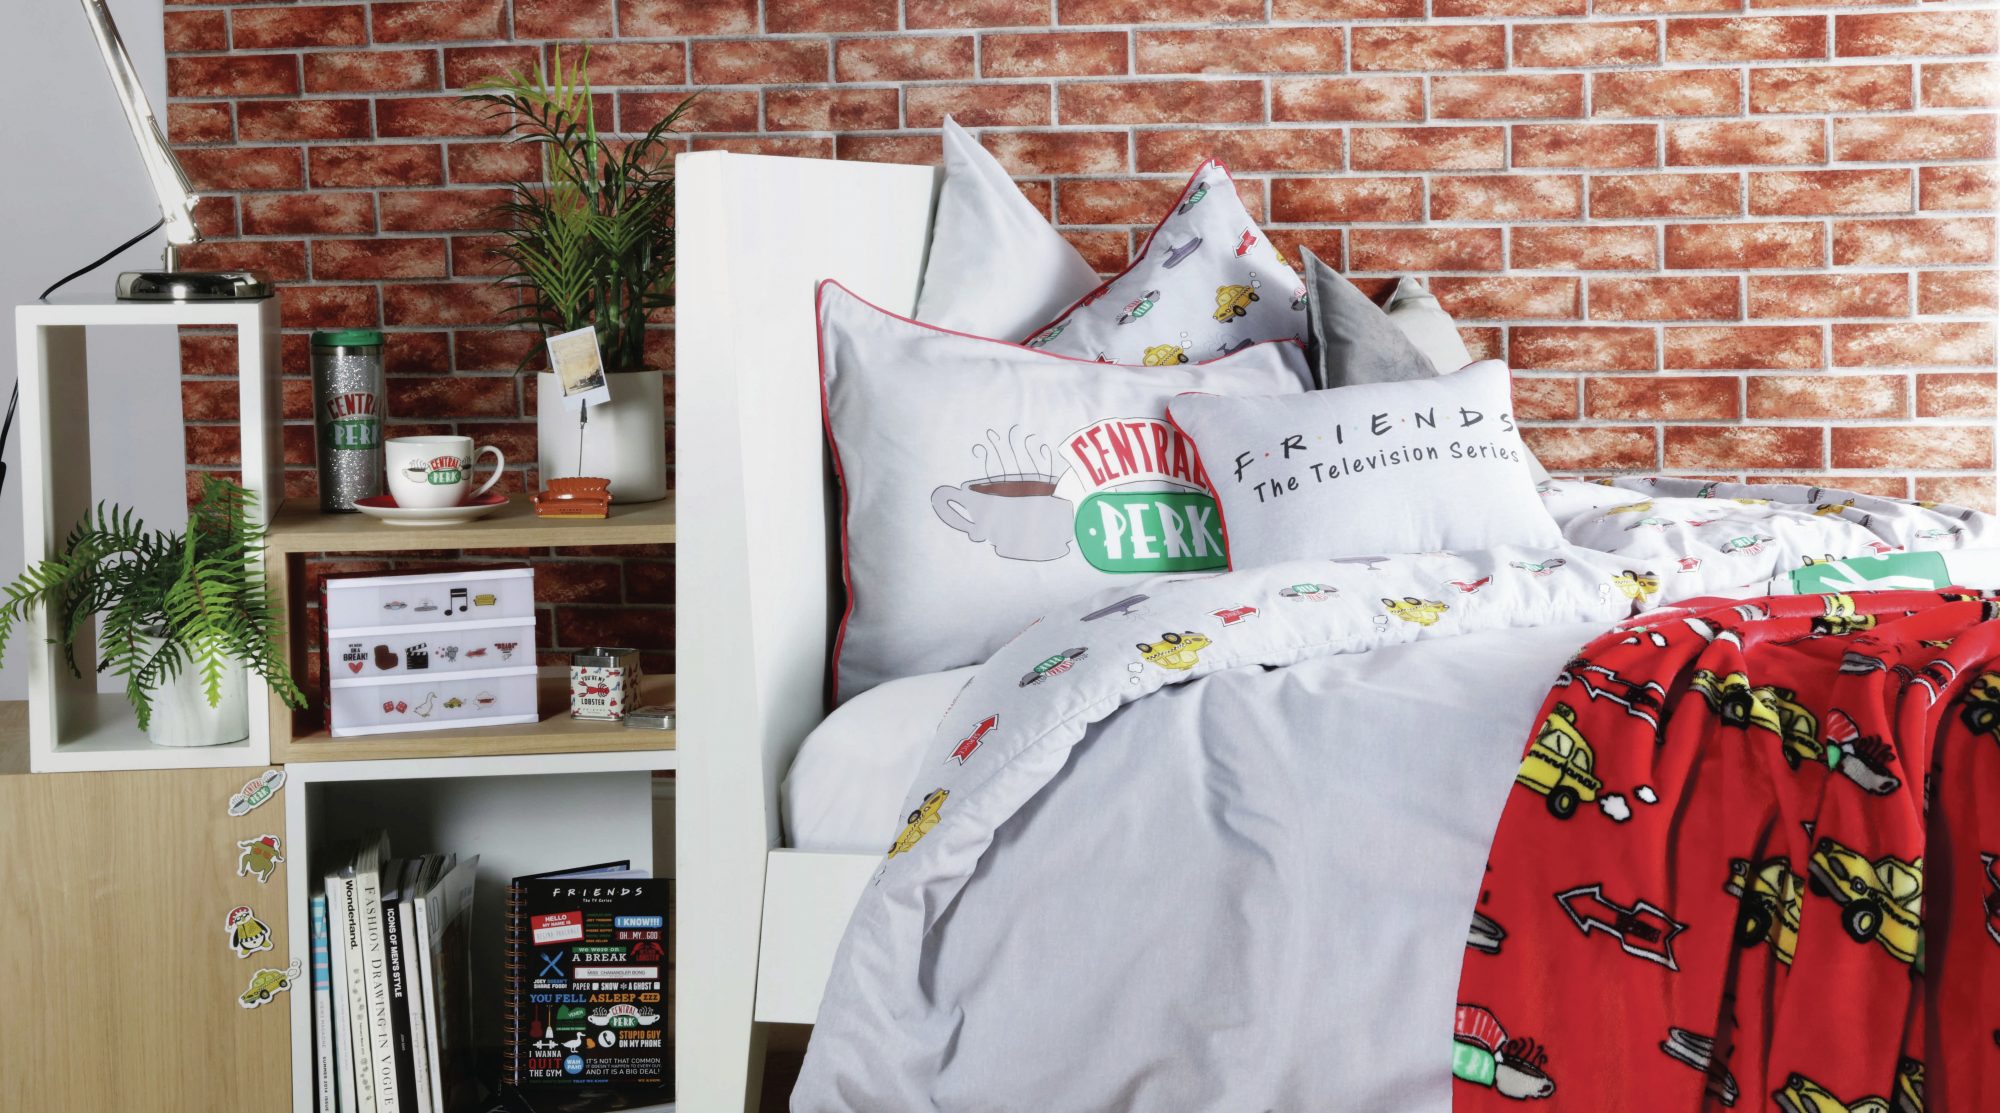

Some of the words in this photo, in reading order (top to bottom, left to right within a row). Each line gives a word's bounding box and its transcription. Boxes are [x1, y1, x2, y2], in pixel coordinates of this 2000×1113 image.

[1070, 421, 1208, 489] CENTRAL
[430, 456, 460, 471] CENTRAL
[433, 471, 458, 483] PERK
[1253, 476, 1300, 503] The
[1309, 444, 1439, 483] Television
[1449, 441, 1520, 463] Series
[1097, 500, 1225, 560] PERK
[343, 652, 368, 661] BREAK!
[581, 698, 605, 706] LOBSTER
[345, 879, 358, 950] Wonderland.
[364, 886, 379, 952] FASHION
[387, 908, 396, 934] ICONS
[389, 934, 397, 946] OF
[390, 946, 400, 971] MEN'S
[571, 953, 582, 961] A
[585, 953, 627, 961] BREAK
[392, 971, 402, 998] STYLE
[572, 982, 590, 990] PAPER
[601, 982, 619, 990] SNOW
[633, 982, 652, 990] GHOST
[371, 959, 387, 1028] DRAWING
[530, 994, 552, 1002] YOU
[555, 994, 586, 1002] FELL
[589, 993, 636, 1002] ASLEEP
[611, 1005, 635, 1015] CENTRAL
[613, 1017, 634, 1026] PERK
[378, 1033, 389, 1048] IN
[619, 1030, 644, 1039] STUPID
[646, 1030, 660, 1039] GUY
[619, 1039, 629, 1047] ON
[629, 1039, 640, 1047] MY
[640, 1039, 661, 1047] PHONE
[528, 1057, 561, 1069] QUIT
[381, 1055, 394, 1106] VOGUE
